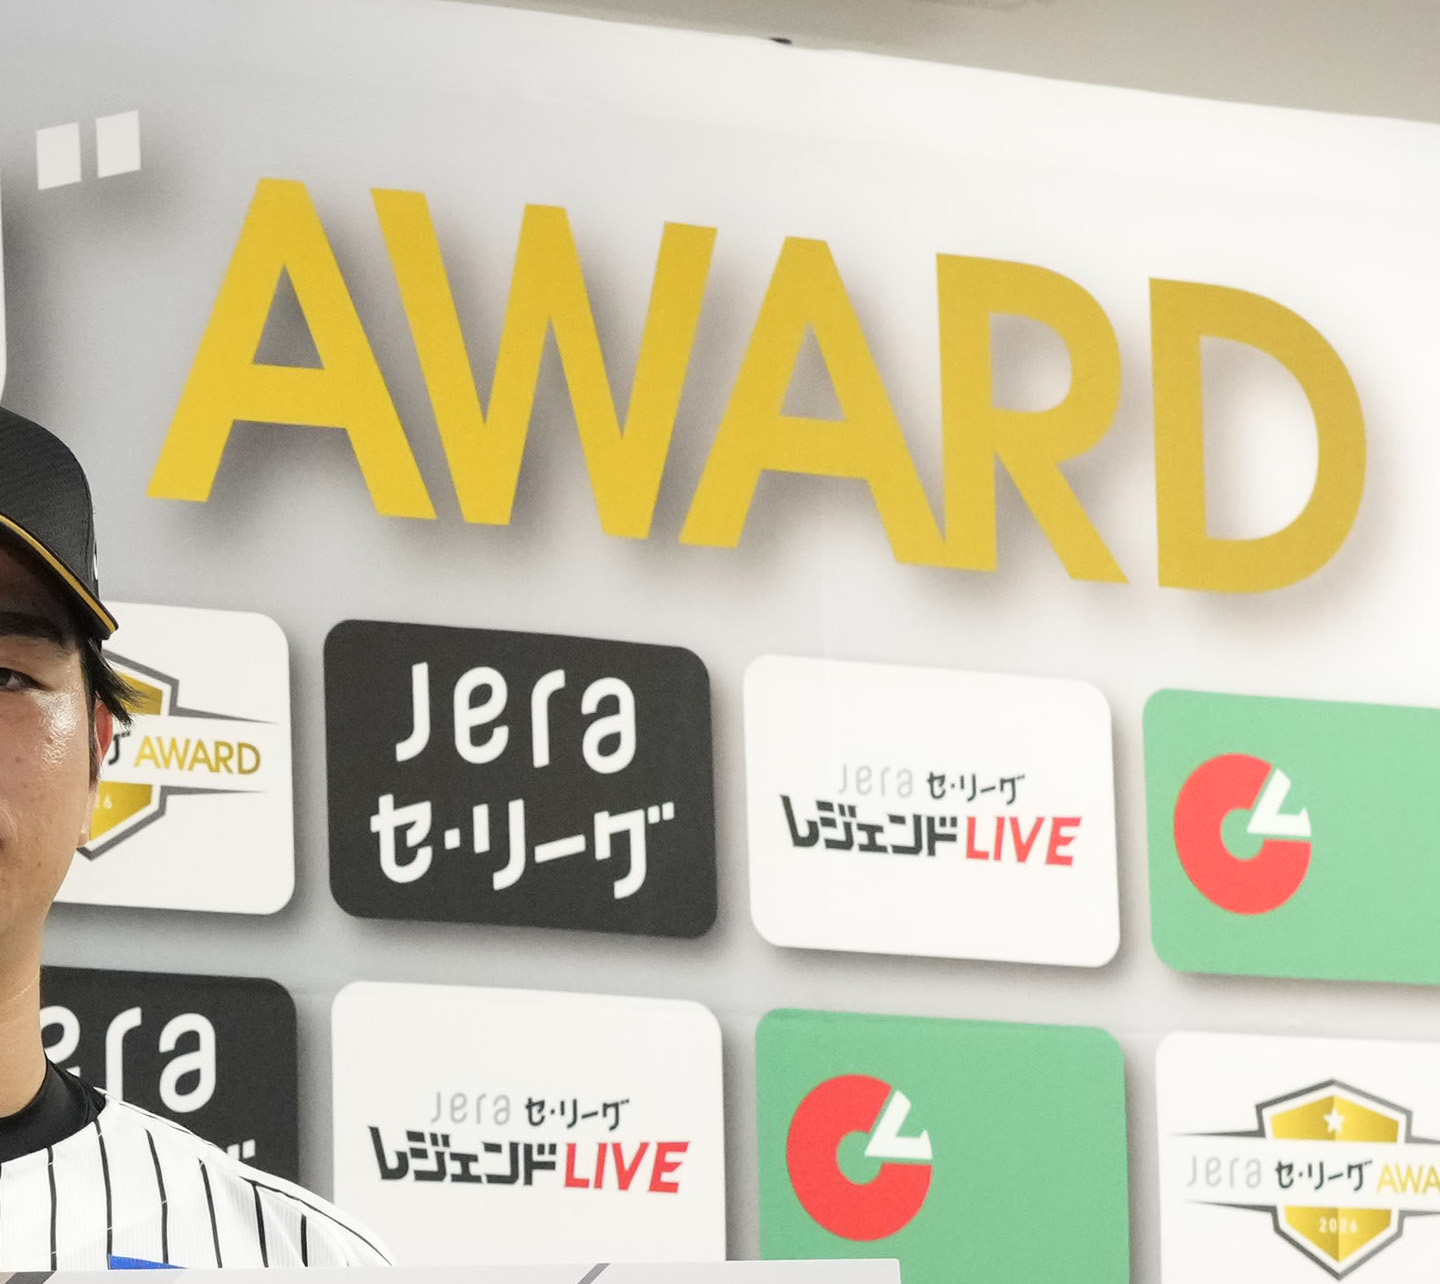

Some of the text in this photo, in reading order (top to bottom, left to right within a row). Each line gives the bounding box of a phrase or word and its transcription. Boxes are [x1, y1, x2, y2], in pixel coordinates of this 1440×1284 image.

[146, 177, 1367, 594] AWARD
[134, 736, 261, 775] AWARD
[927, 772, 1025, 805] セ・リーグ
[370, 793, 675, 899] セ・リーグ
[525, 1097, 630, 1131] セ・リーグ
[1275, 1160, 1373, 1192] セ・リーグ
[1376, 1163, 1440, 1195] AWA
[1319, 1217, 1358, 1234] 2026
